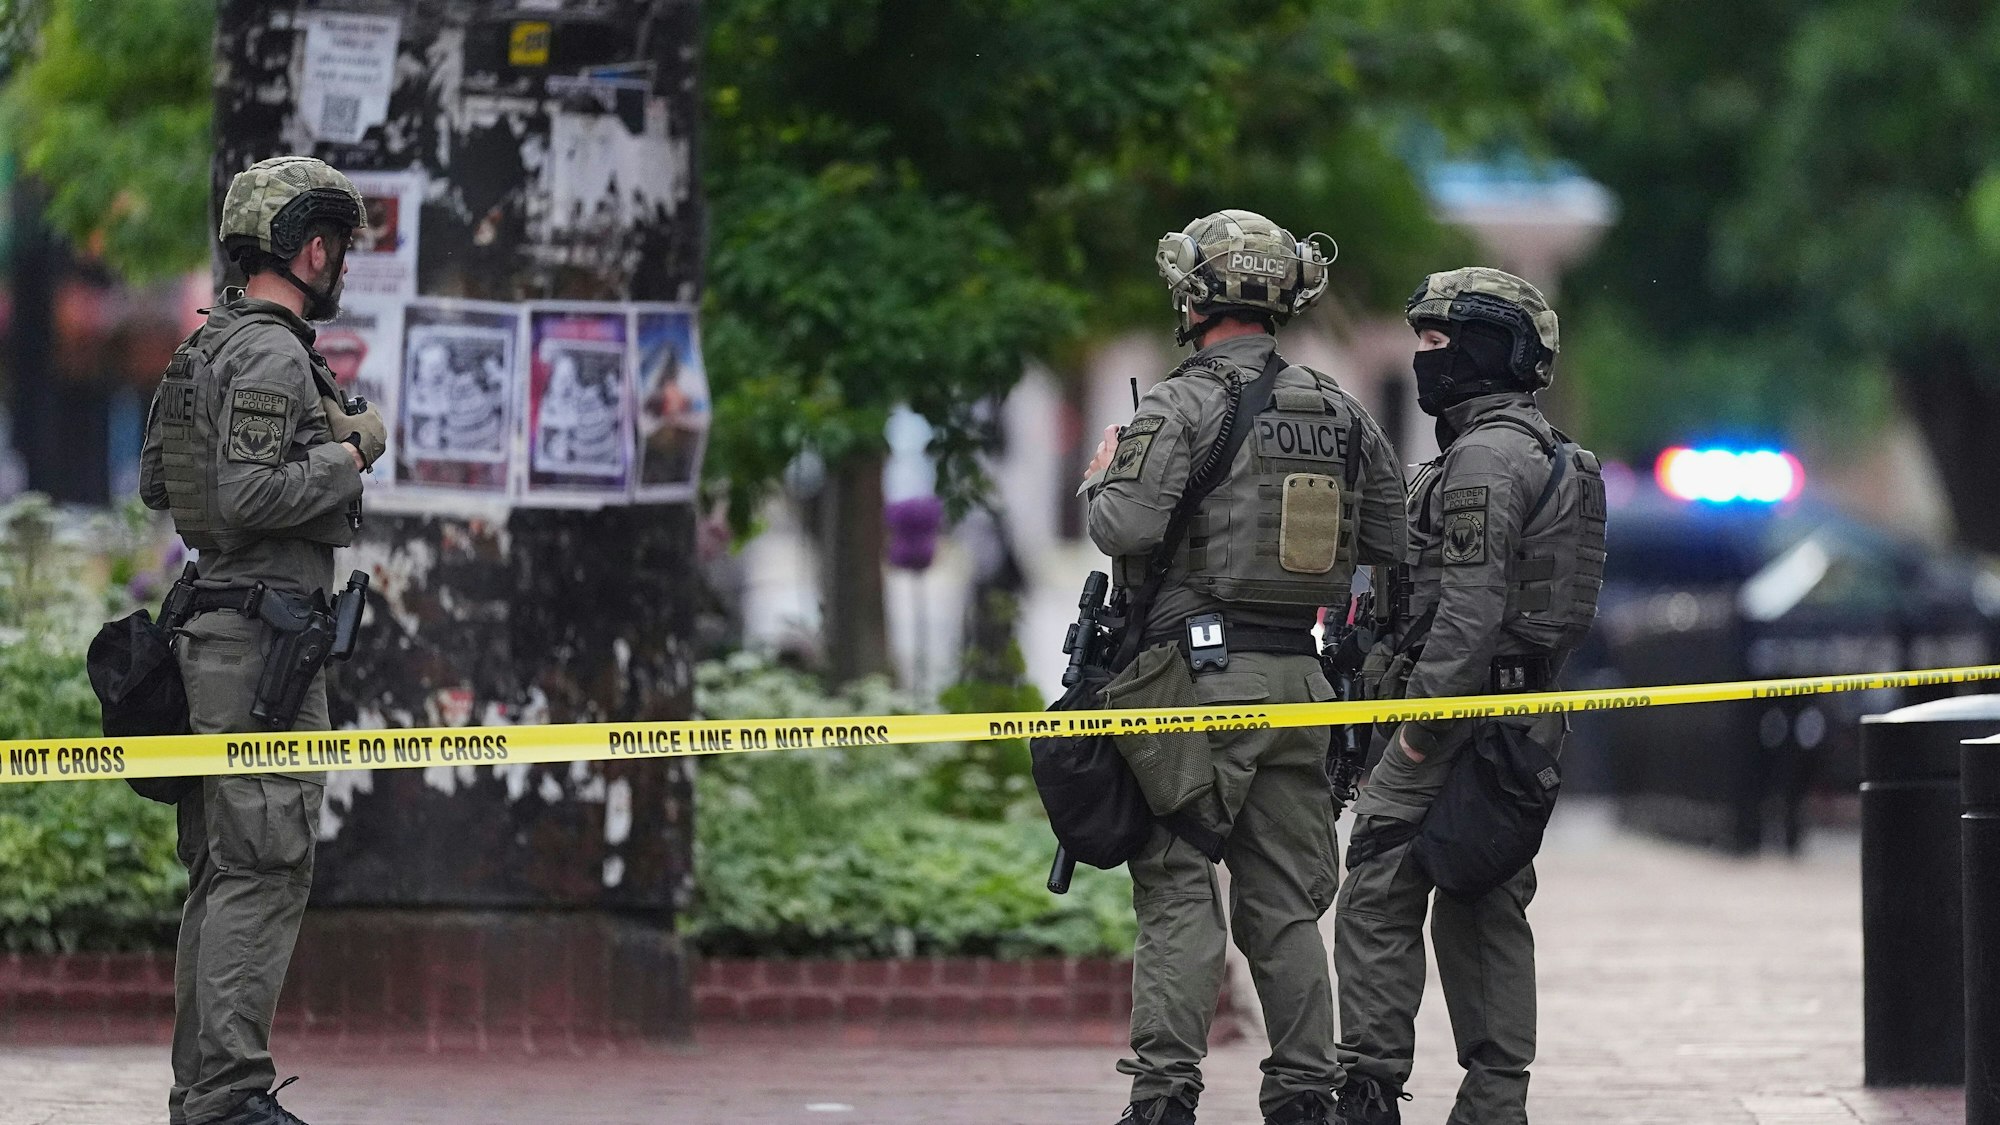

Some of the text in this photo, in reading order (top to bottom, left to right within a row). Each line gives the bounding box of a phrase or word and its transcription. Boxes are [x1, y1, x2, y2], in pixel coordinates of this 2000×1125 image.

[1232, 252, 1284, 275] POLICE
[238, 391, 284, 405] BOULDER
[242, 400, 278, 412] POLICE
[1260, 420, 1347, 459] POLICE
[1445, 488, 1484, 501] BOULDER
[1449, 498, 1479, 509] POLICE
[227, 734, 508, 768] POLICE LINE DO NOT CROSS
[609, 725, 889, 755] POLICE LINE DO NOT CROSS
[10, 748, 49, 775] NOT
[57, 746, 125, 773] CROSS
